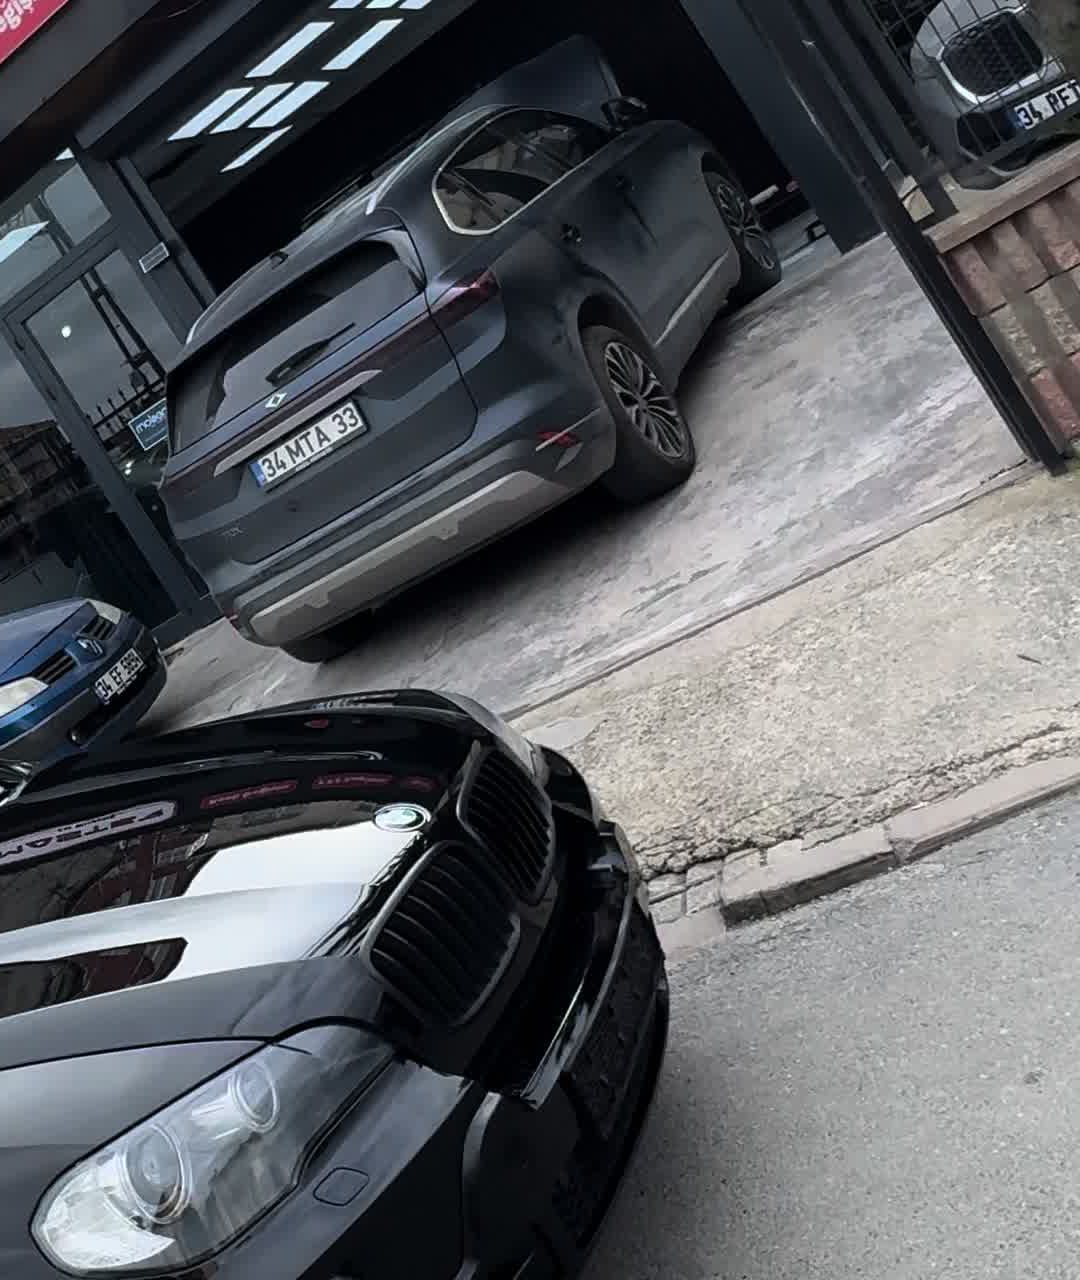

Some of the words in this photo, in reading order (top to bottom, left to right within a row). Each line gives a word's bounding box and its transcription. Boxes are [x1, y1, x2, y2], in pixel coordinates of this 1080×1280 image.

[1016, 101, 1044, 127] 34
[261, 451, 287, 478] 34
[284, 425, 332, 465] MTA
[331, 406, 359, 434] 33
